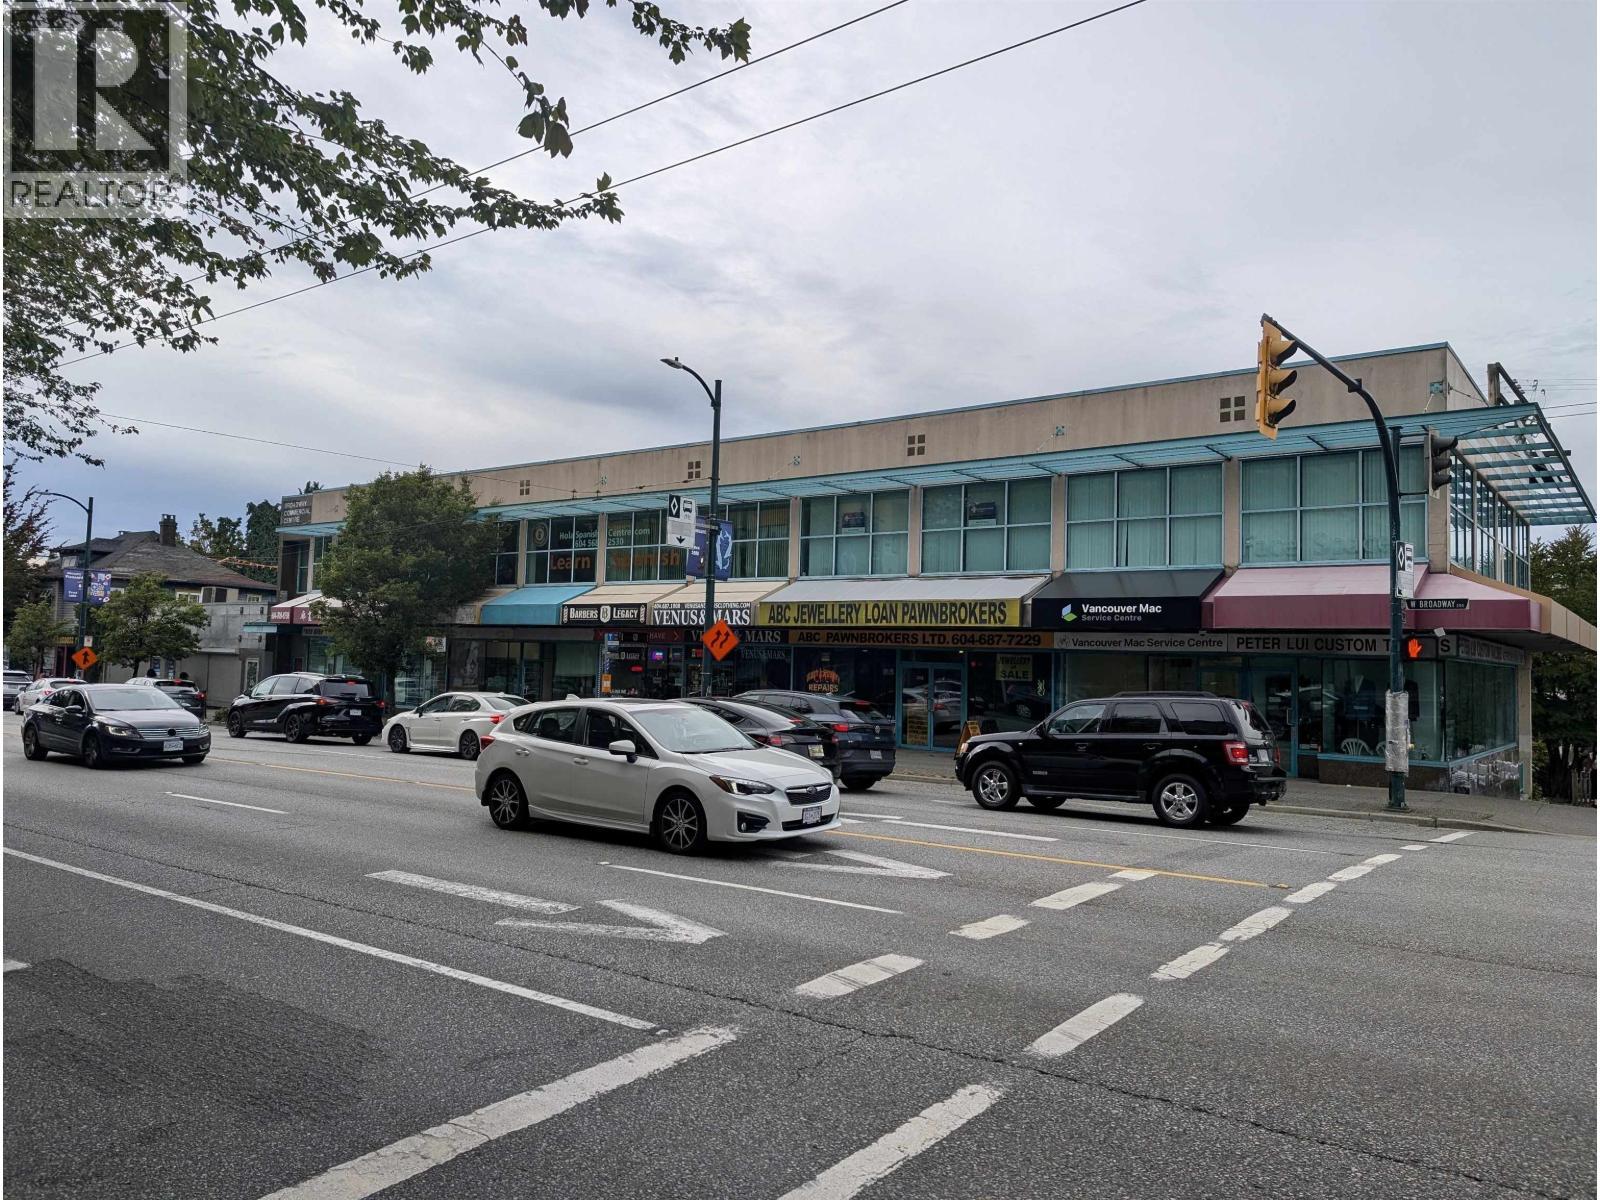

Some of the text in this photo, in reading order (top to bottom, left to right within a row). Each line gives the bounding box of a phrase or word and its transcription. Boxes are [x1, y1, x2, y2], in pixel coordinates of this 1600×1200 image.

[1081, 603, 1162, 613] Vancouver Mac
[1419, 600, 1456, 608] BROADWAY
[569, 607, 599, 619] BARBERS
[613, 607, 639, 619] LEGACY
[768, 601, 1007, 625] ABC JEWELLERY LOAN PAWNBROKERS
[744, 630, 781, 643] MARS
[797, 631, 1042, 646] ABC PAWNBROKERS LTD. 604-687-7229
[1072, 638, 1223, 648] Vancouver Mac Service Centre
[1236, 636, 1281, 650] PETER
[1287, 637, 1309, 650] LUI
[1314, 638, 1377, 652] CUSTOM
[1000, 670, 1029, 680] SALE
[808, 683, 839, 692] REPAIRS
